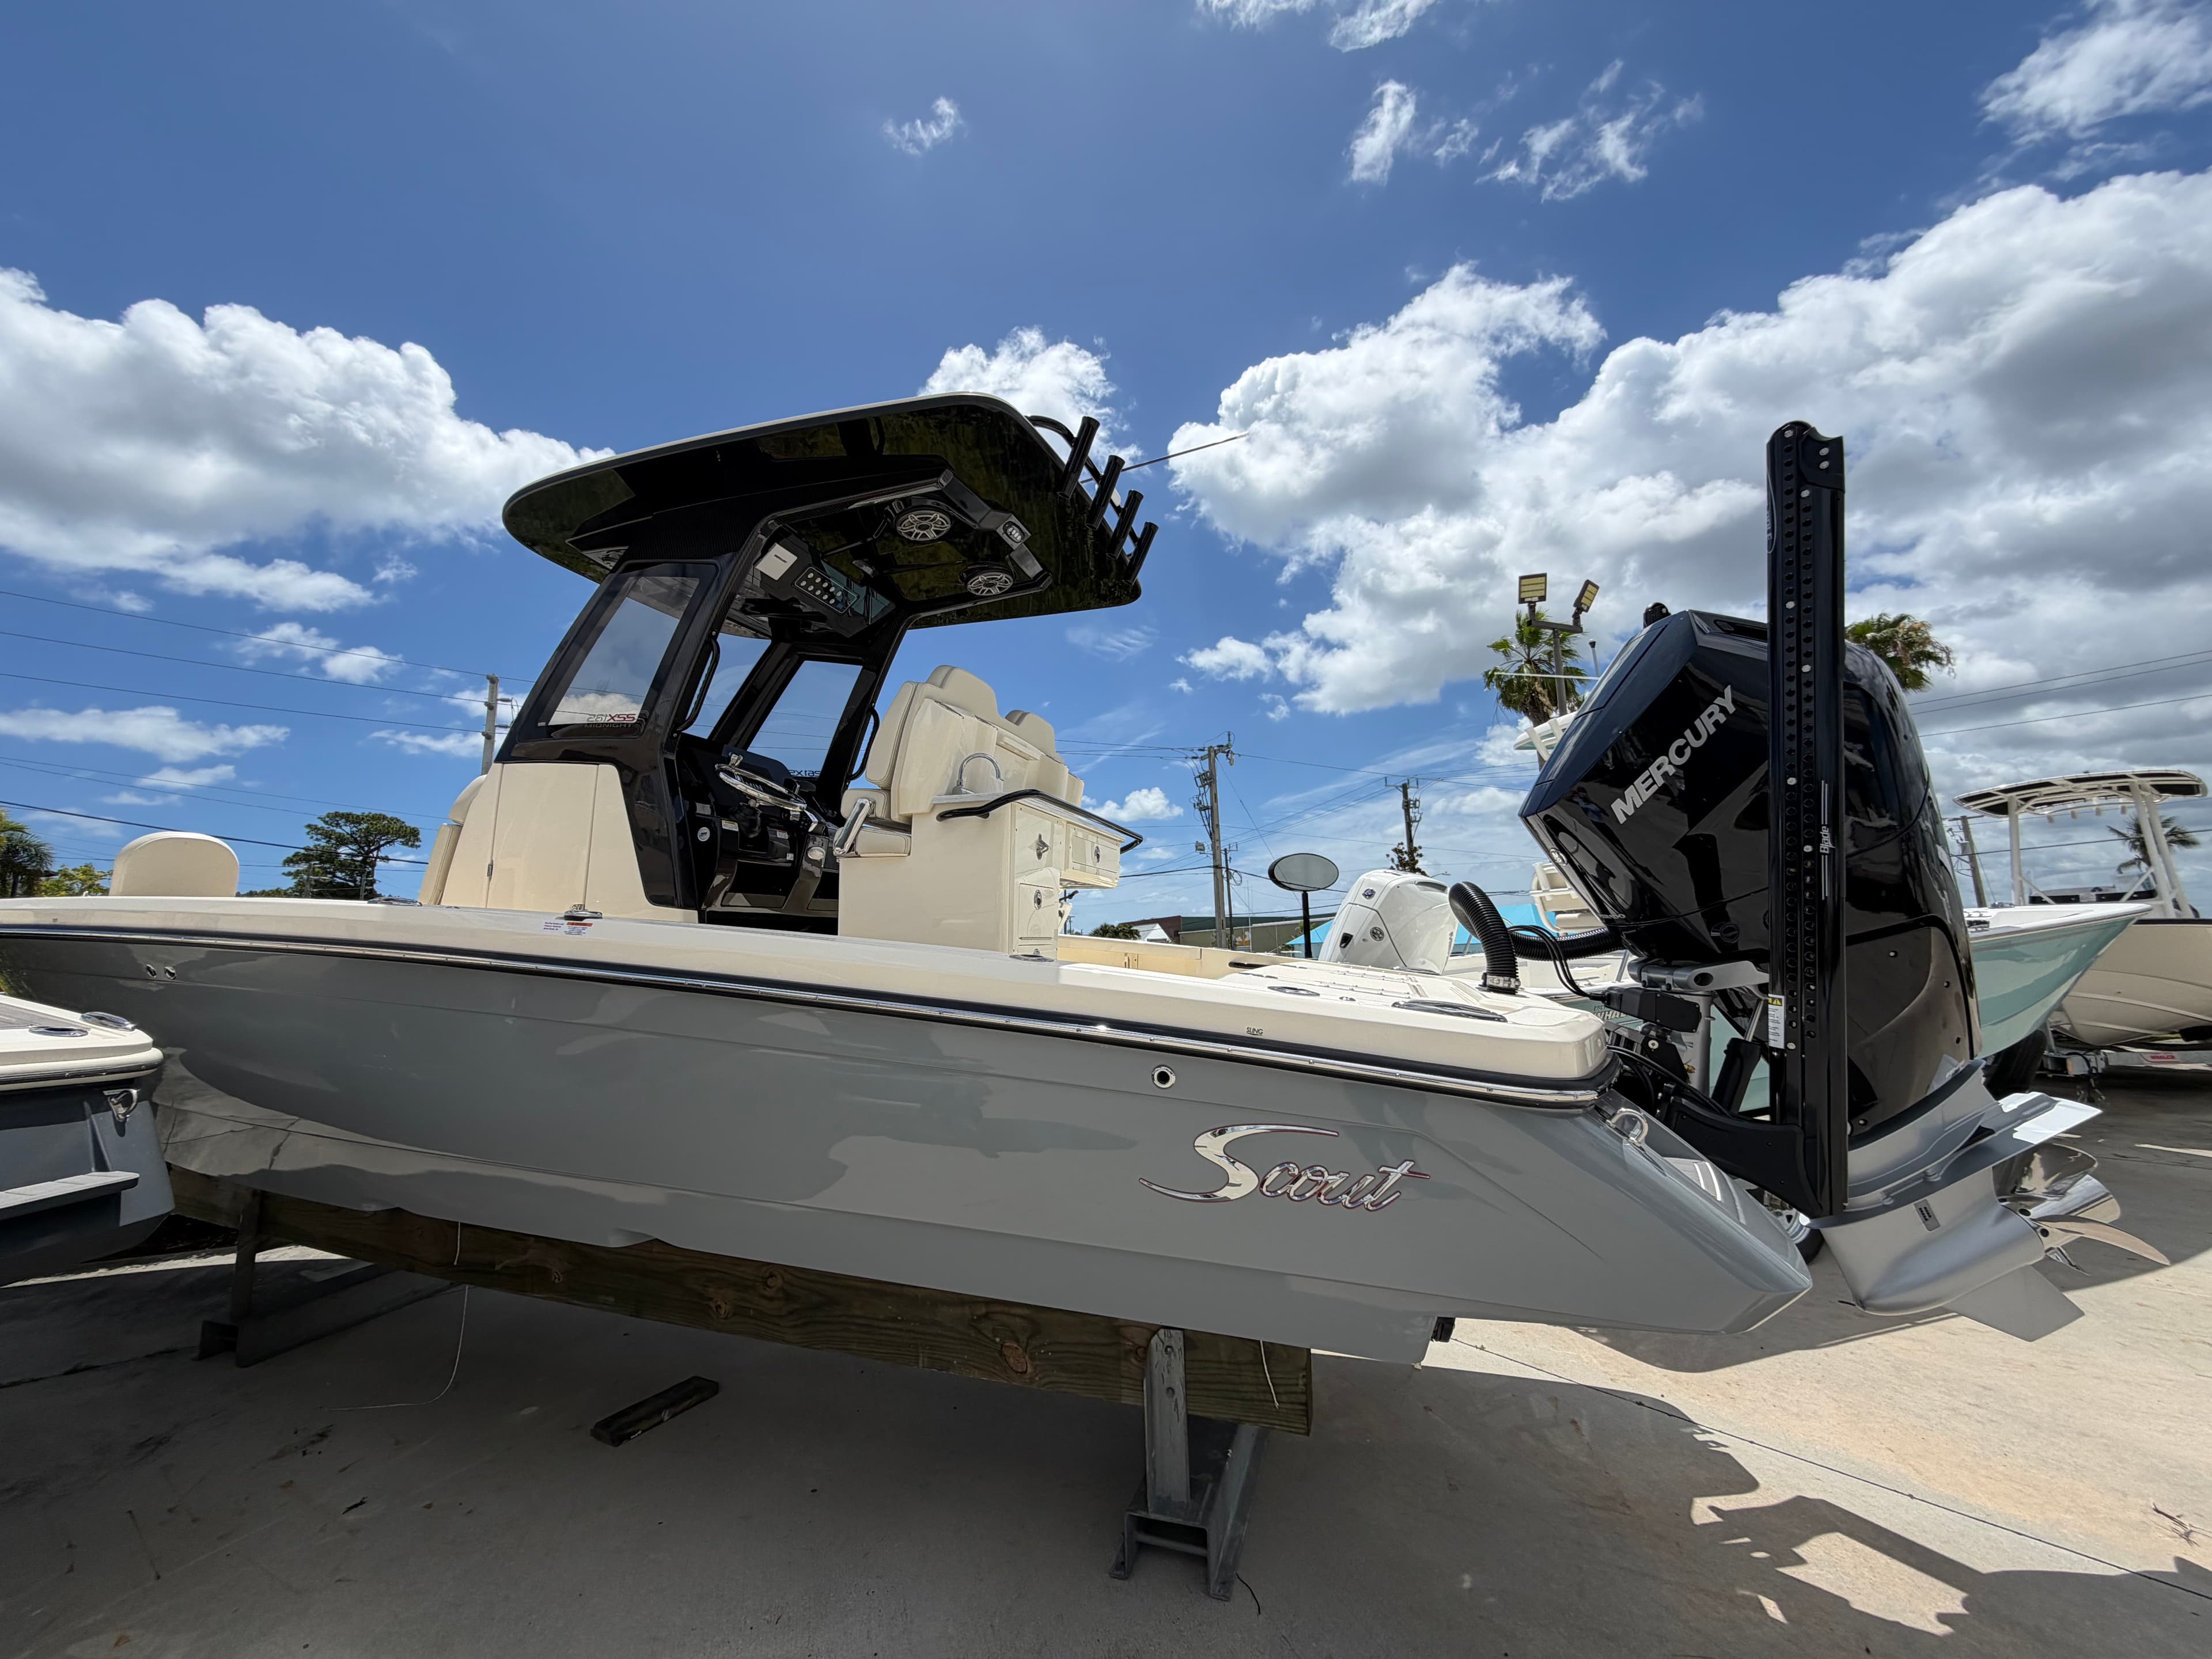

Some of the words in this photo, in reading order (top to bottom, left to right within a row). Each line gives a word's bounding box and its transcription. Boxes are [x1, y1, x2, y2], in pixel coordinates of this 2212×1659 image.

[1610, 685, 1737, 824] MERCURY
[1820, 825, 1834, 854] Blade
[1246, 1027, 1263, 1035] SLING
[1138, 1122, 1431, 1212] Scout
